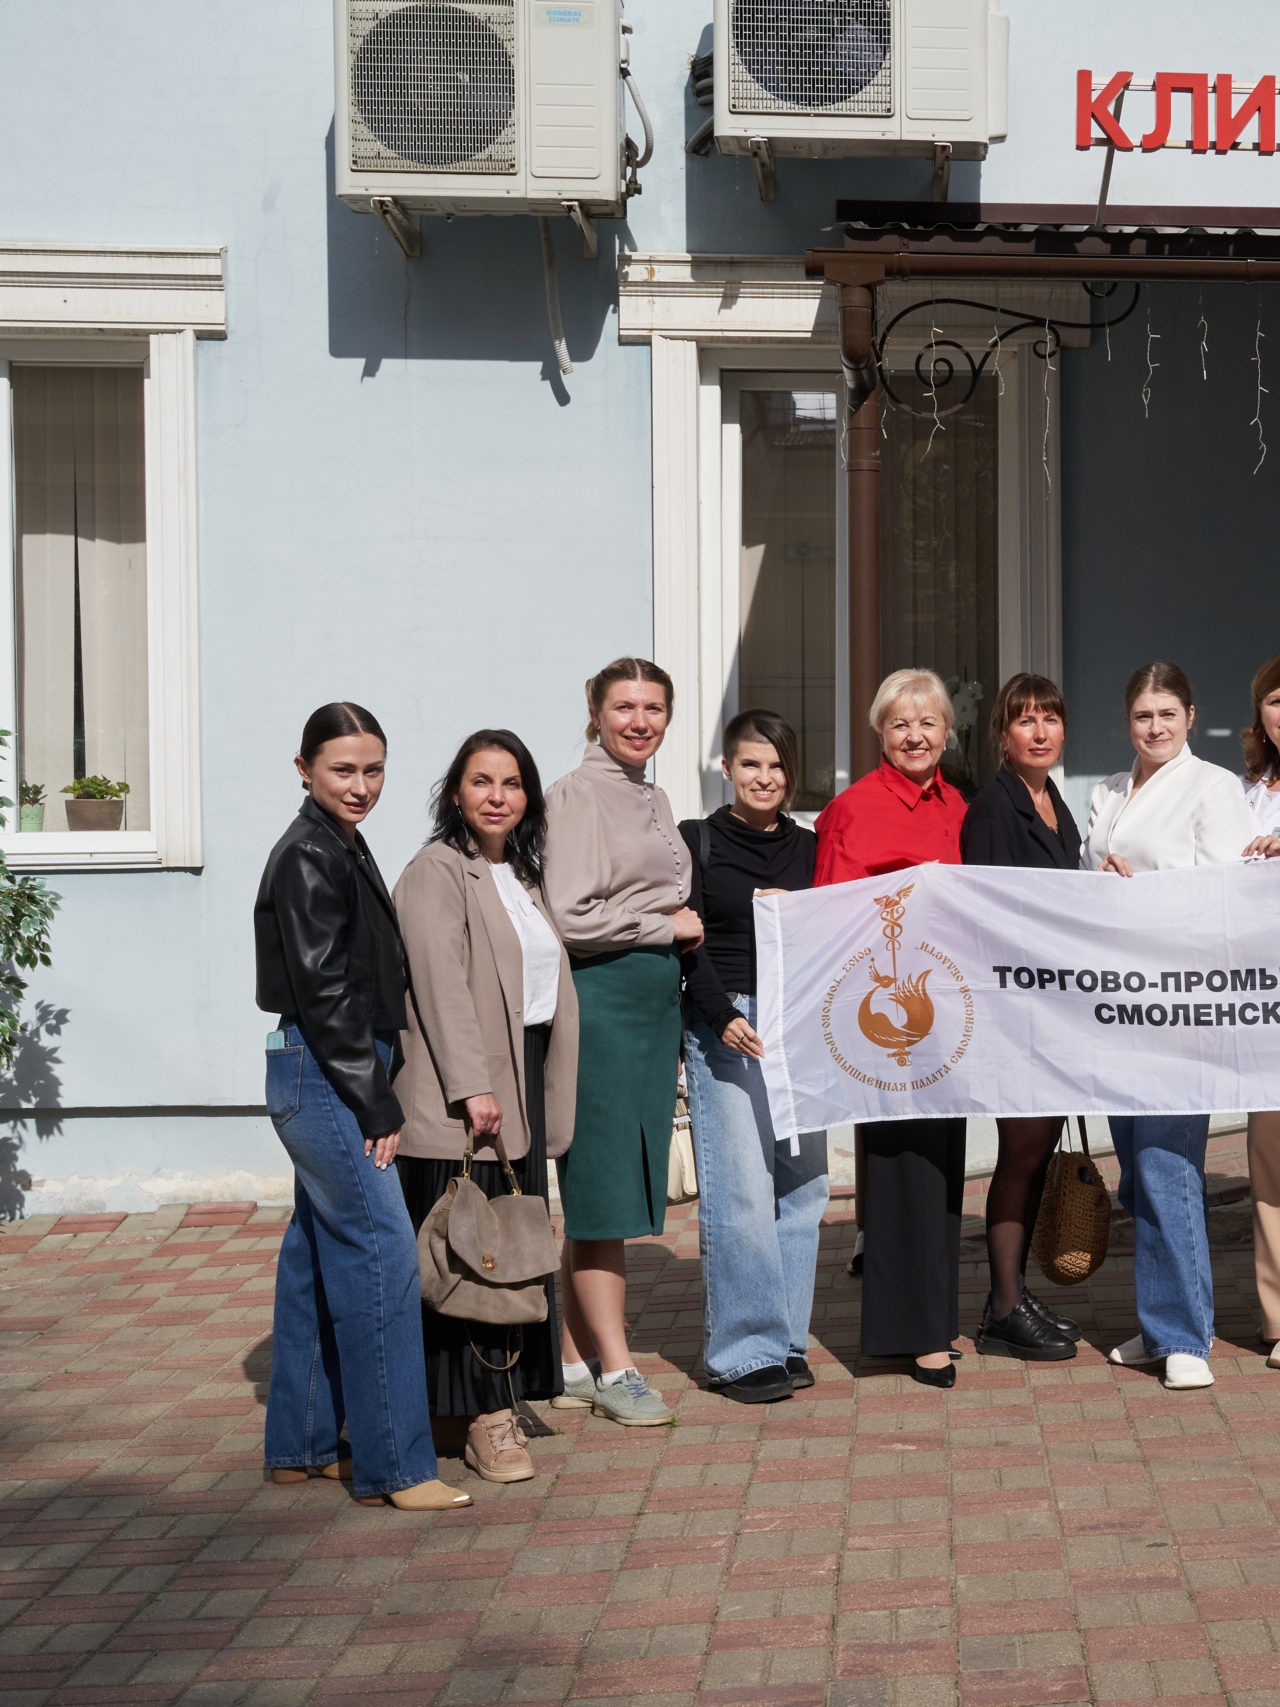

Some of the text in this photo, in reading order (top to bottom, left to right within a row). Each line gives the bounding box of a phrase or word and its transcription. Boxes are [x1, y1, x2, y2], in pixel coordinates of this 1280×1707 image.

[843, 947, 872, 973] СОЮЗ
[912, 1065, 952, 1091] ПАЛАТА
[950, 985, 975, 1065] СМОЛЕНСКОЙ
